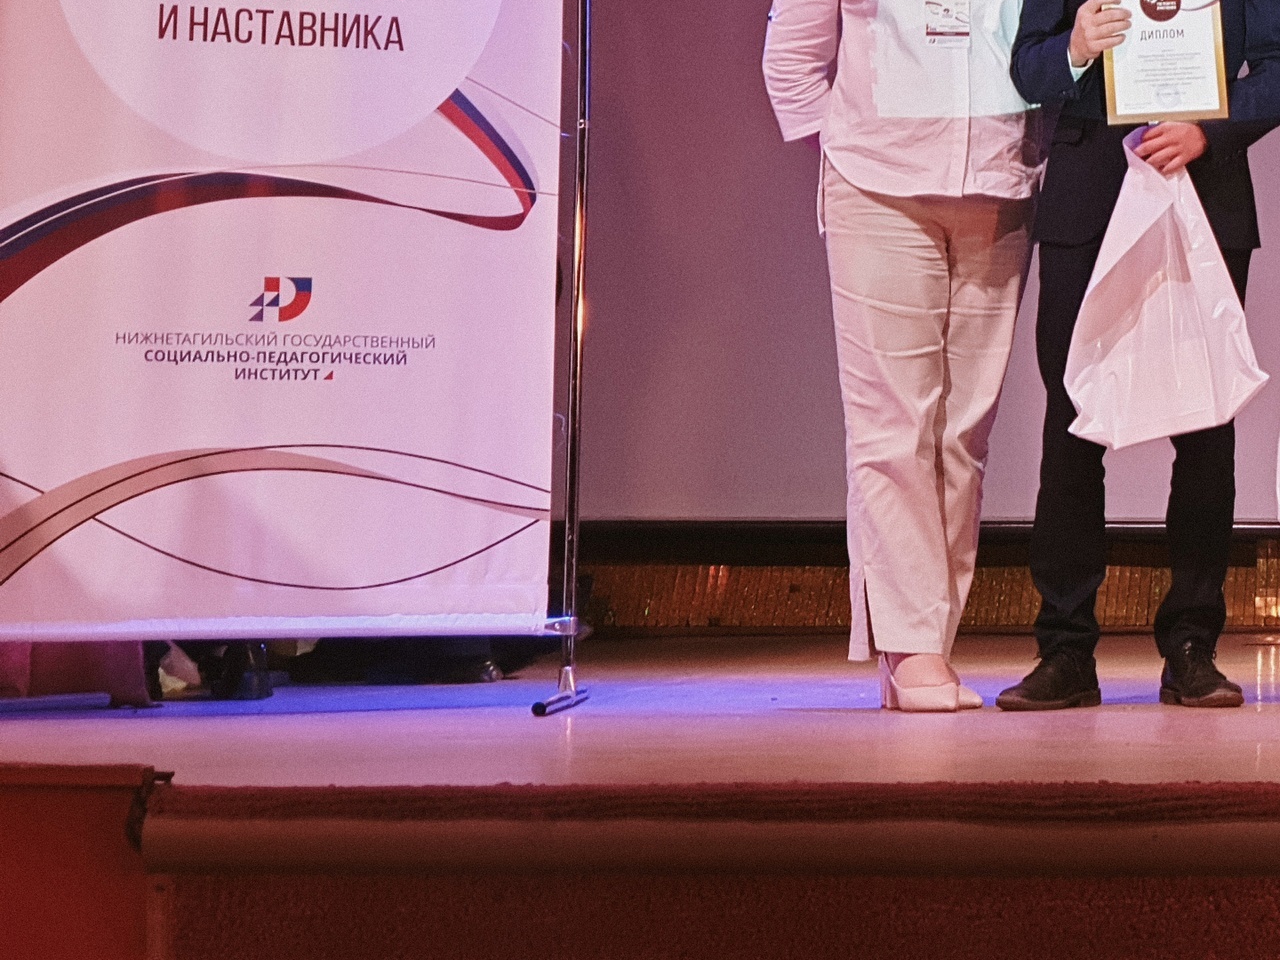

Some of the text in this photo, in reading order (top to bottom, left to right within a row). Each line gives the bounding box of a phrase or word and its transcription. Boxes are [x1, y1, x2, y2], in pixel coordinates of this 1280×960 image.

[157, 3, 405, 52] И НАСТАВНИКА
[1139, 28, 1186, 42] ДИПЛОМ
[115, 331, 436, 350] НИЖНЕТАГИЛЬСКИЙ ГОСУДАРСТВЕННЫЙ
[143, 348, 408, 367] СОЦИАЛЬНО-ПЕДАГОГИЧЕСКИЙ
[234, 367, 320, 381] ИНСТИТУТ
